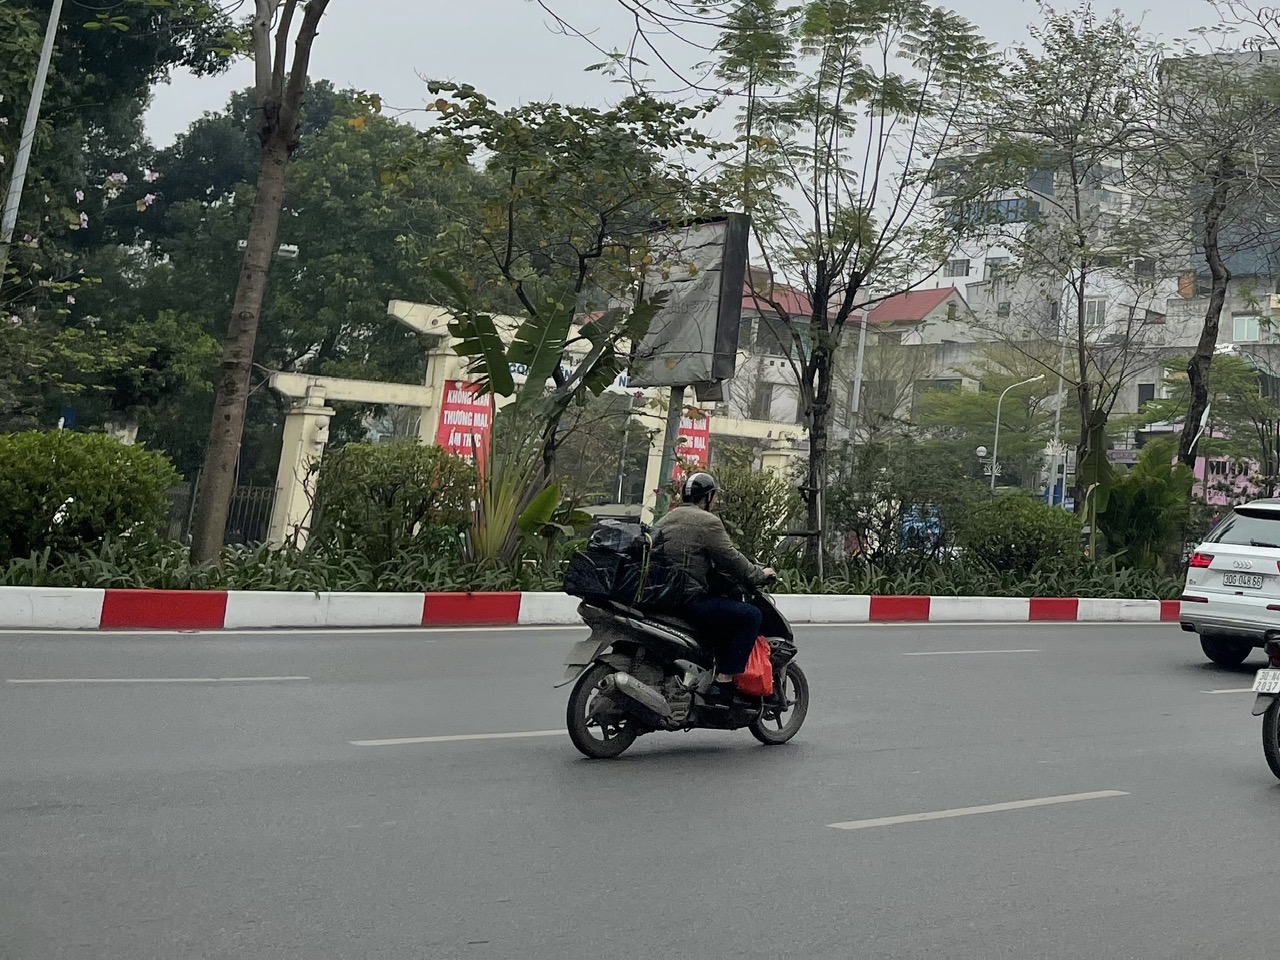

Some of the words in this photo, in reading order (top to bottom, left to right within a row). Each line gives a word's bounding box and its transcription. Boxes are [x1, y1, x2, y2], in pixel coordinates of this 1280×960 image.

[447, 388, 473, 405] KHÔNG
[443, 409, 473, 426] THƯƠNG
[1255, 681, 1279, 691] 2037
